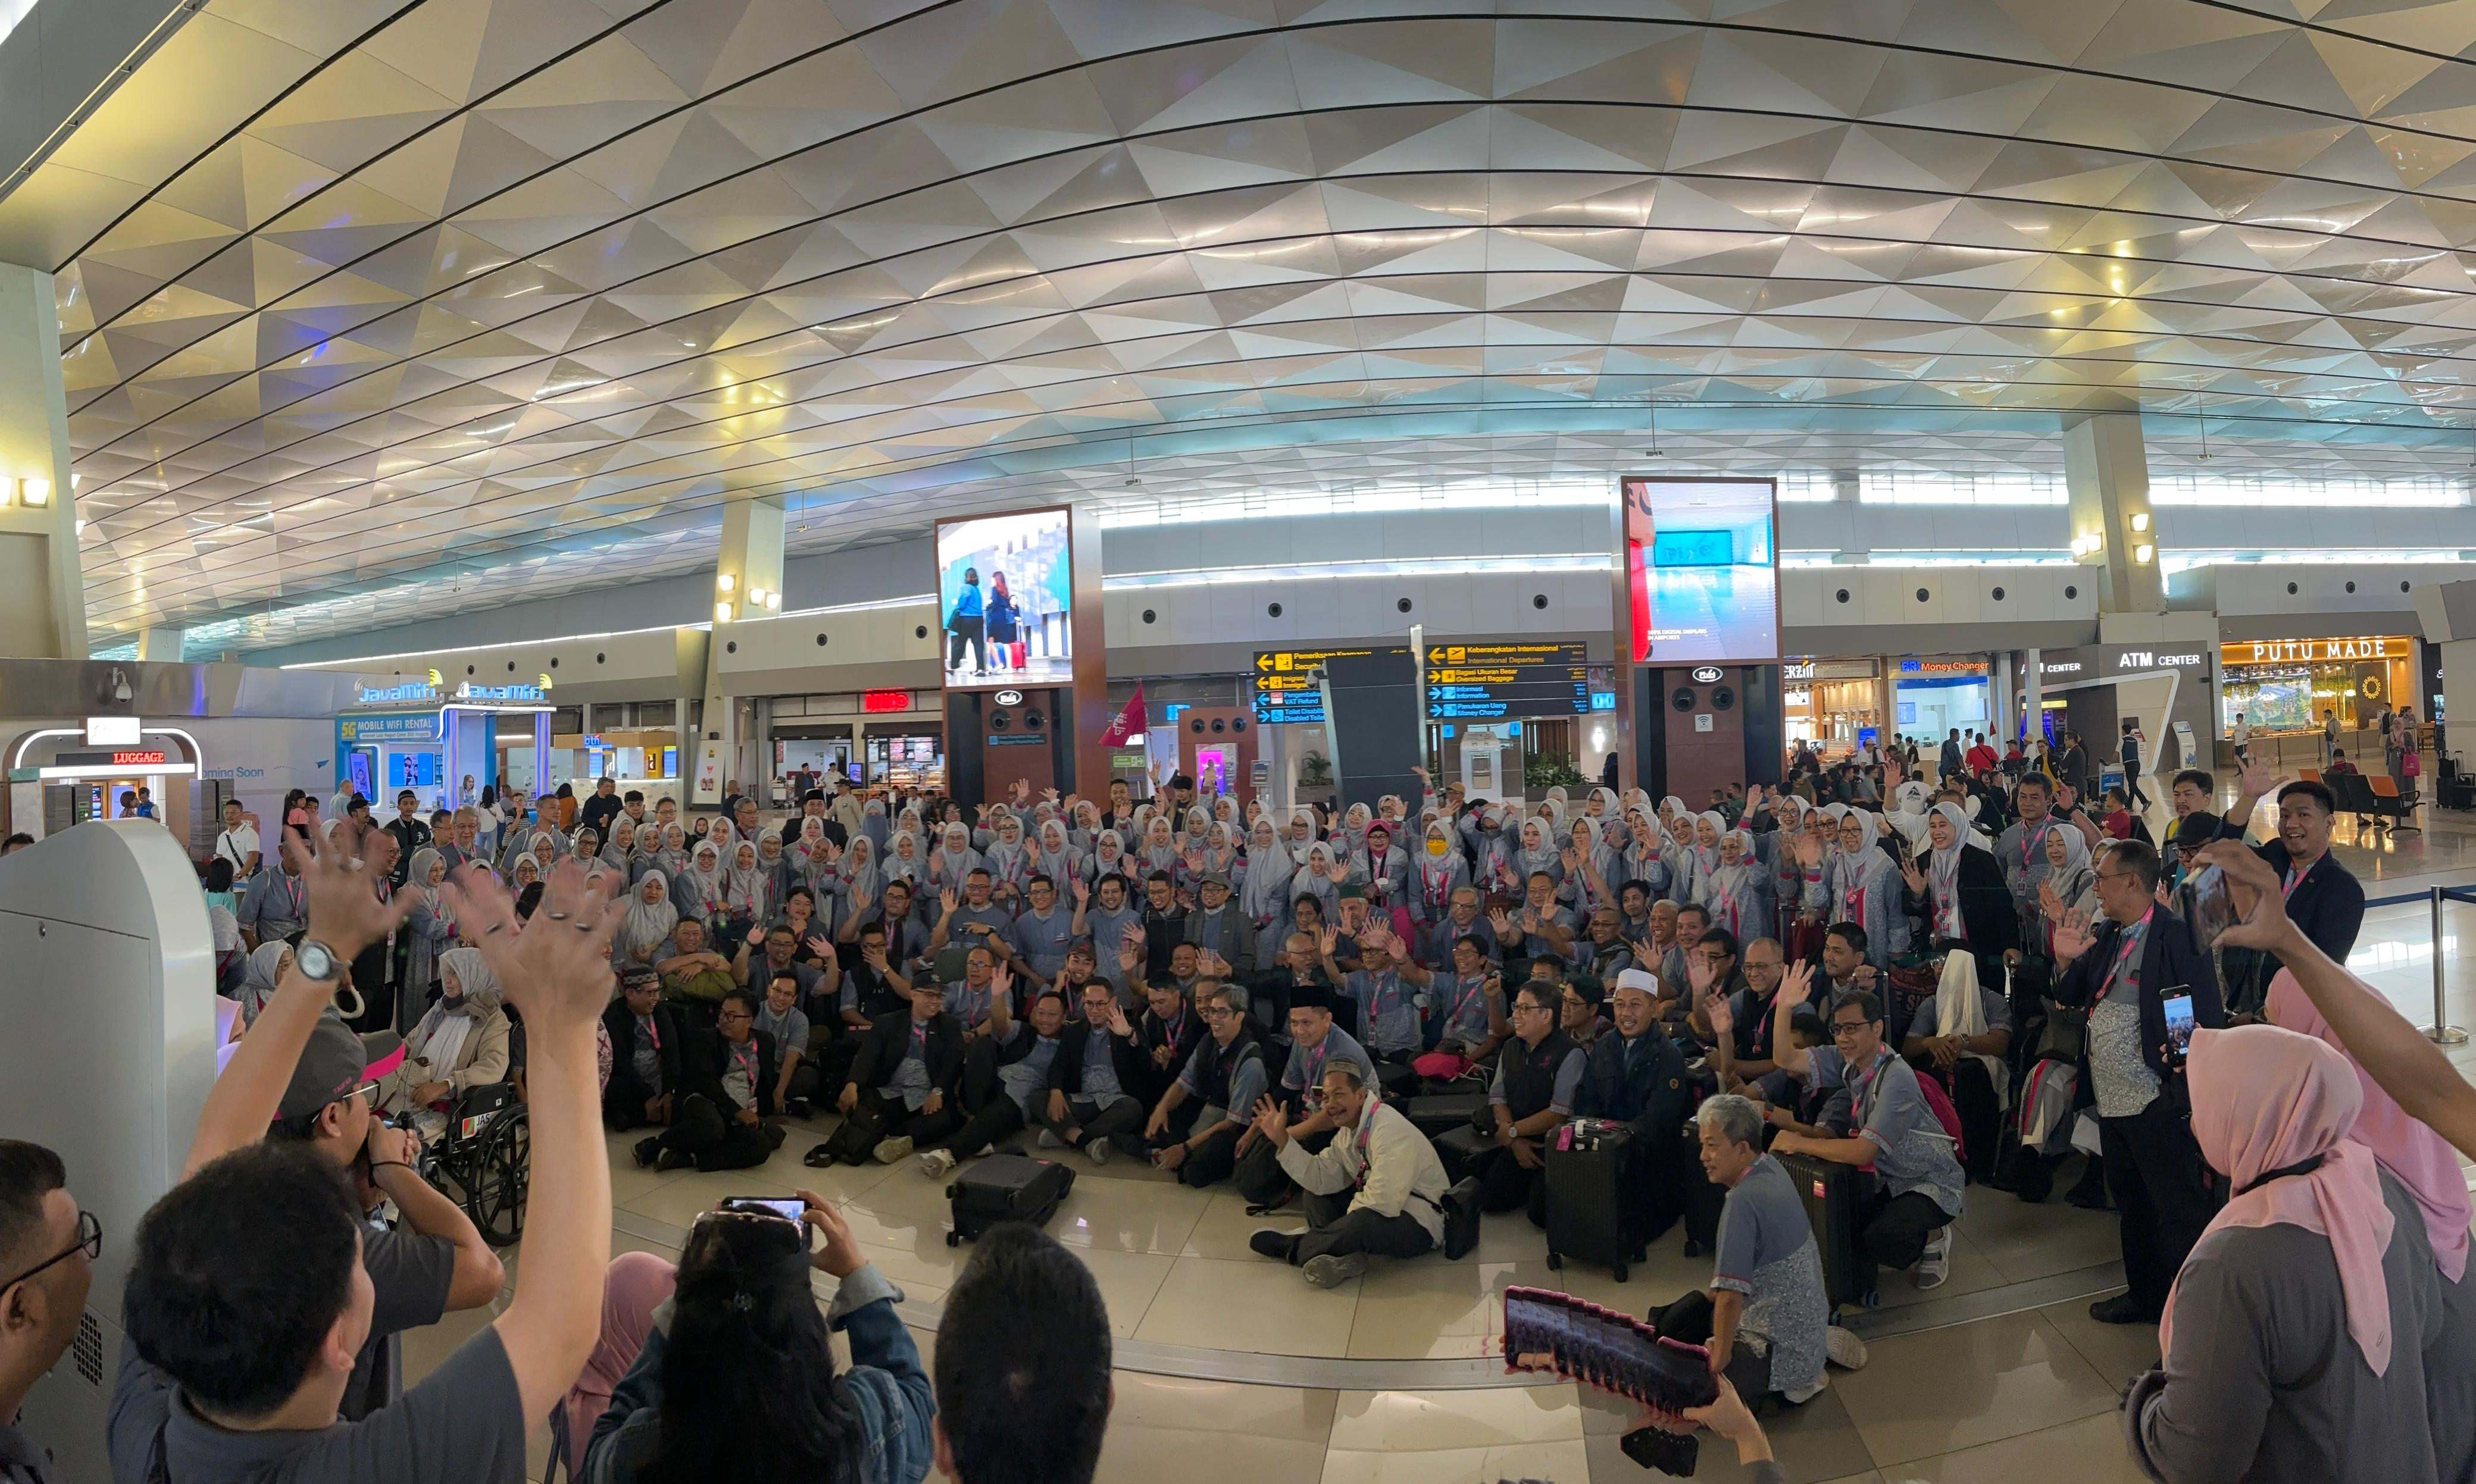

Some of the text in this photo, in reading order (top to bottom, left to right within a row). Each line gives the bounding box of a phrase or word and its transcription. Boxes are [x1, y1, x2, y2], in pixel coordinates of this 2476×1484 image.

[2253, 640, 2385, 662] PUTU MADE
[2119, 652, 2200, 667] ATM CENTER
[1901, 661, 1989, 672] BRI Money Changer
[2047, 663, 2081, 672] CENTER
[341, 721, 356, 738] 5G
[358, 718, 433, 731] MOBILE WIFI RENTAL
[114, 752, 164, 764] LUGGAGE
[236, 766, 264, 778] Soon
[476, 1113, 490, 1126] JAS
